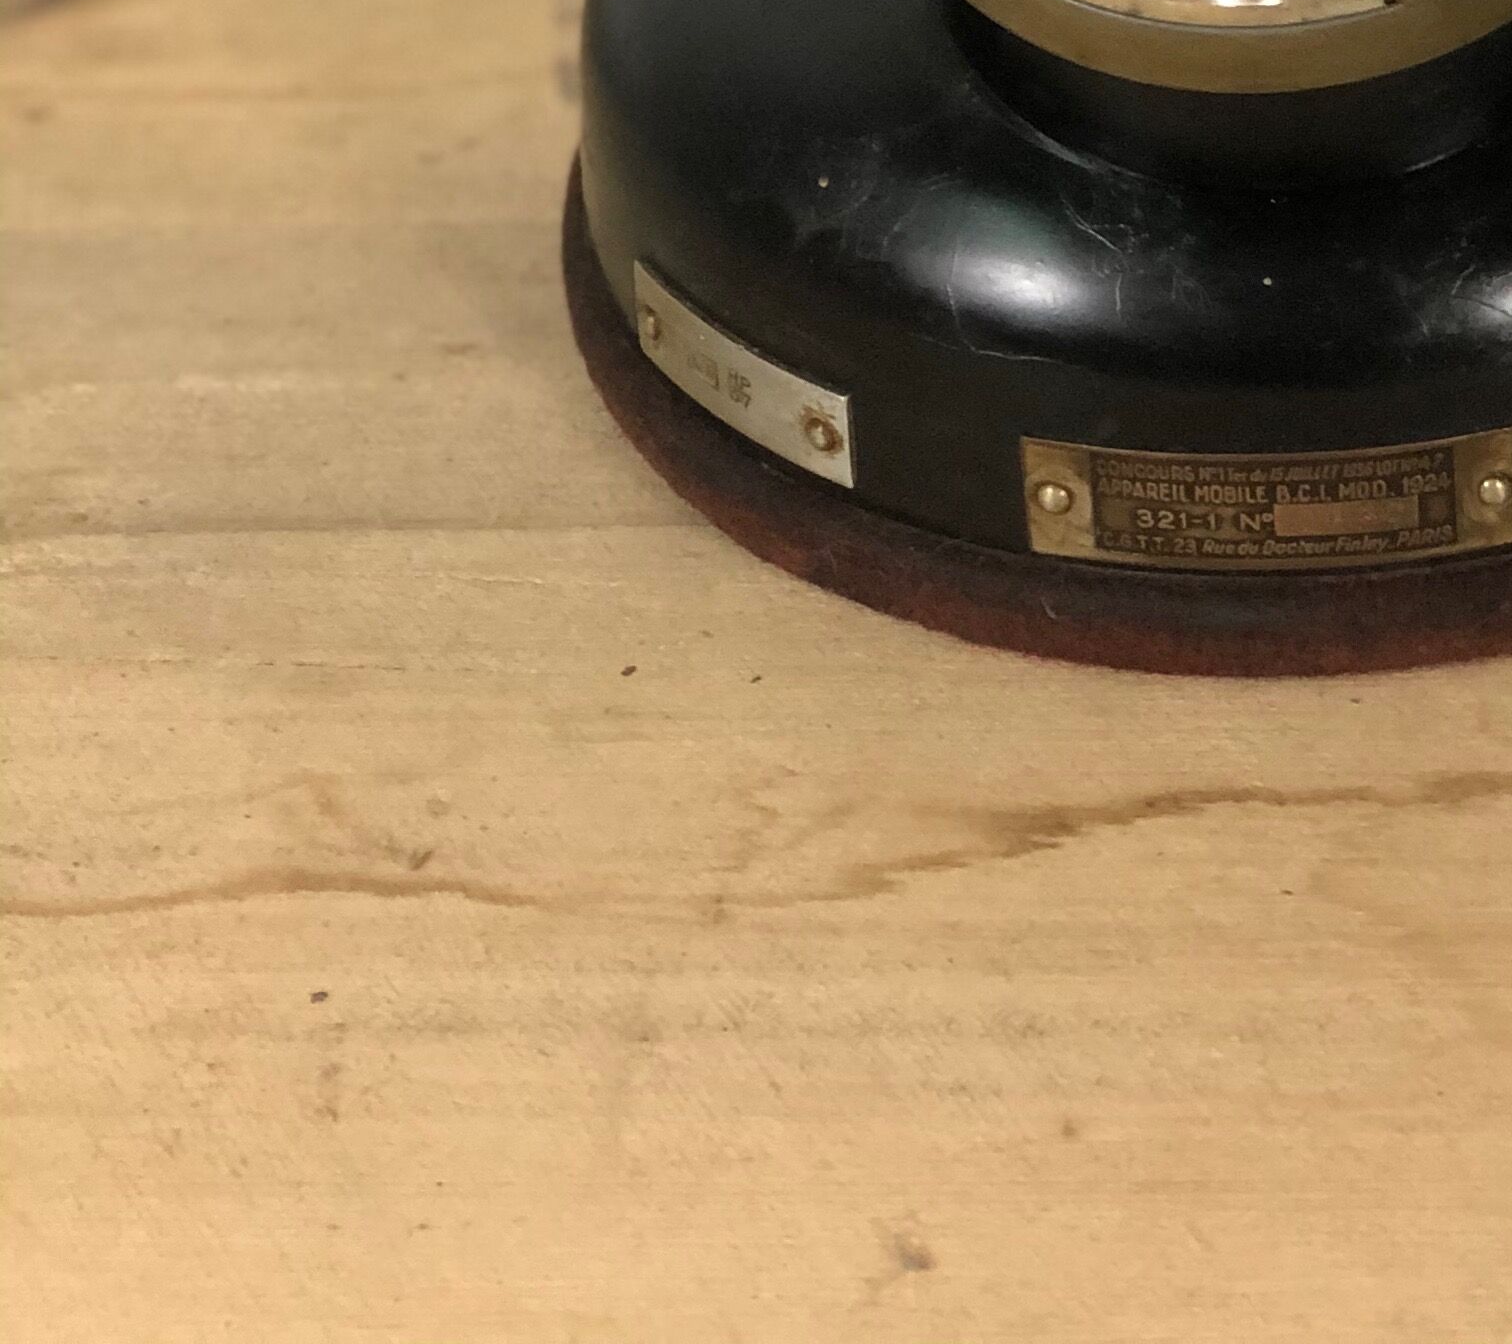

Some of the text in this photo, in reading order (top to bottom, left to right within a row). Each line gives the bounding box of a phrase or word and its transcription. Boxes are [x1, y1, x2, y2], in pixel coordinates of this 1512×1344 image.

[1098, 478, 1189, 503] APPAREIL
[1194, 484, 1269, 504] MOBILE
[1402, 471, 1450, 494] 1924
[1135, 508, 1217, 531] 321-1
